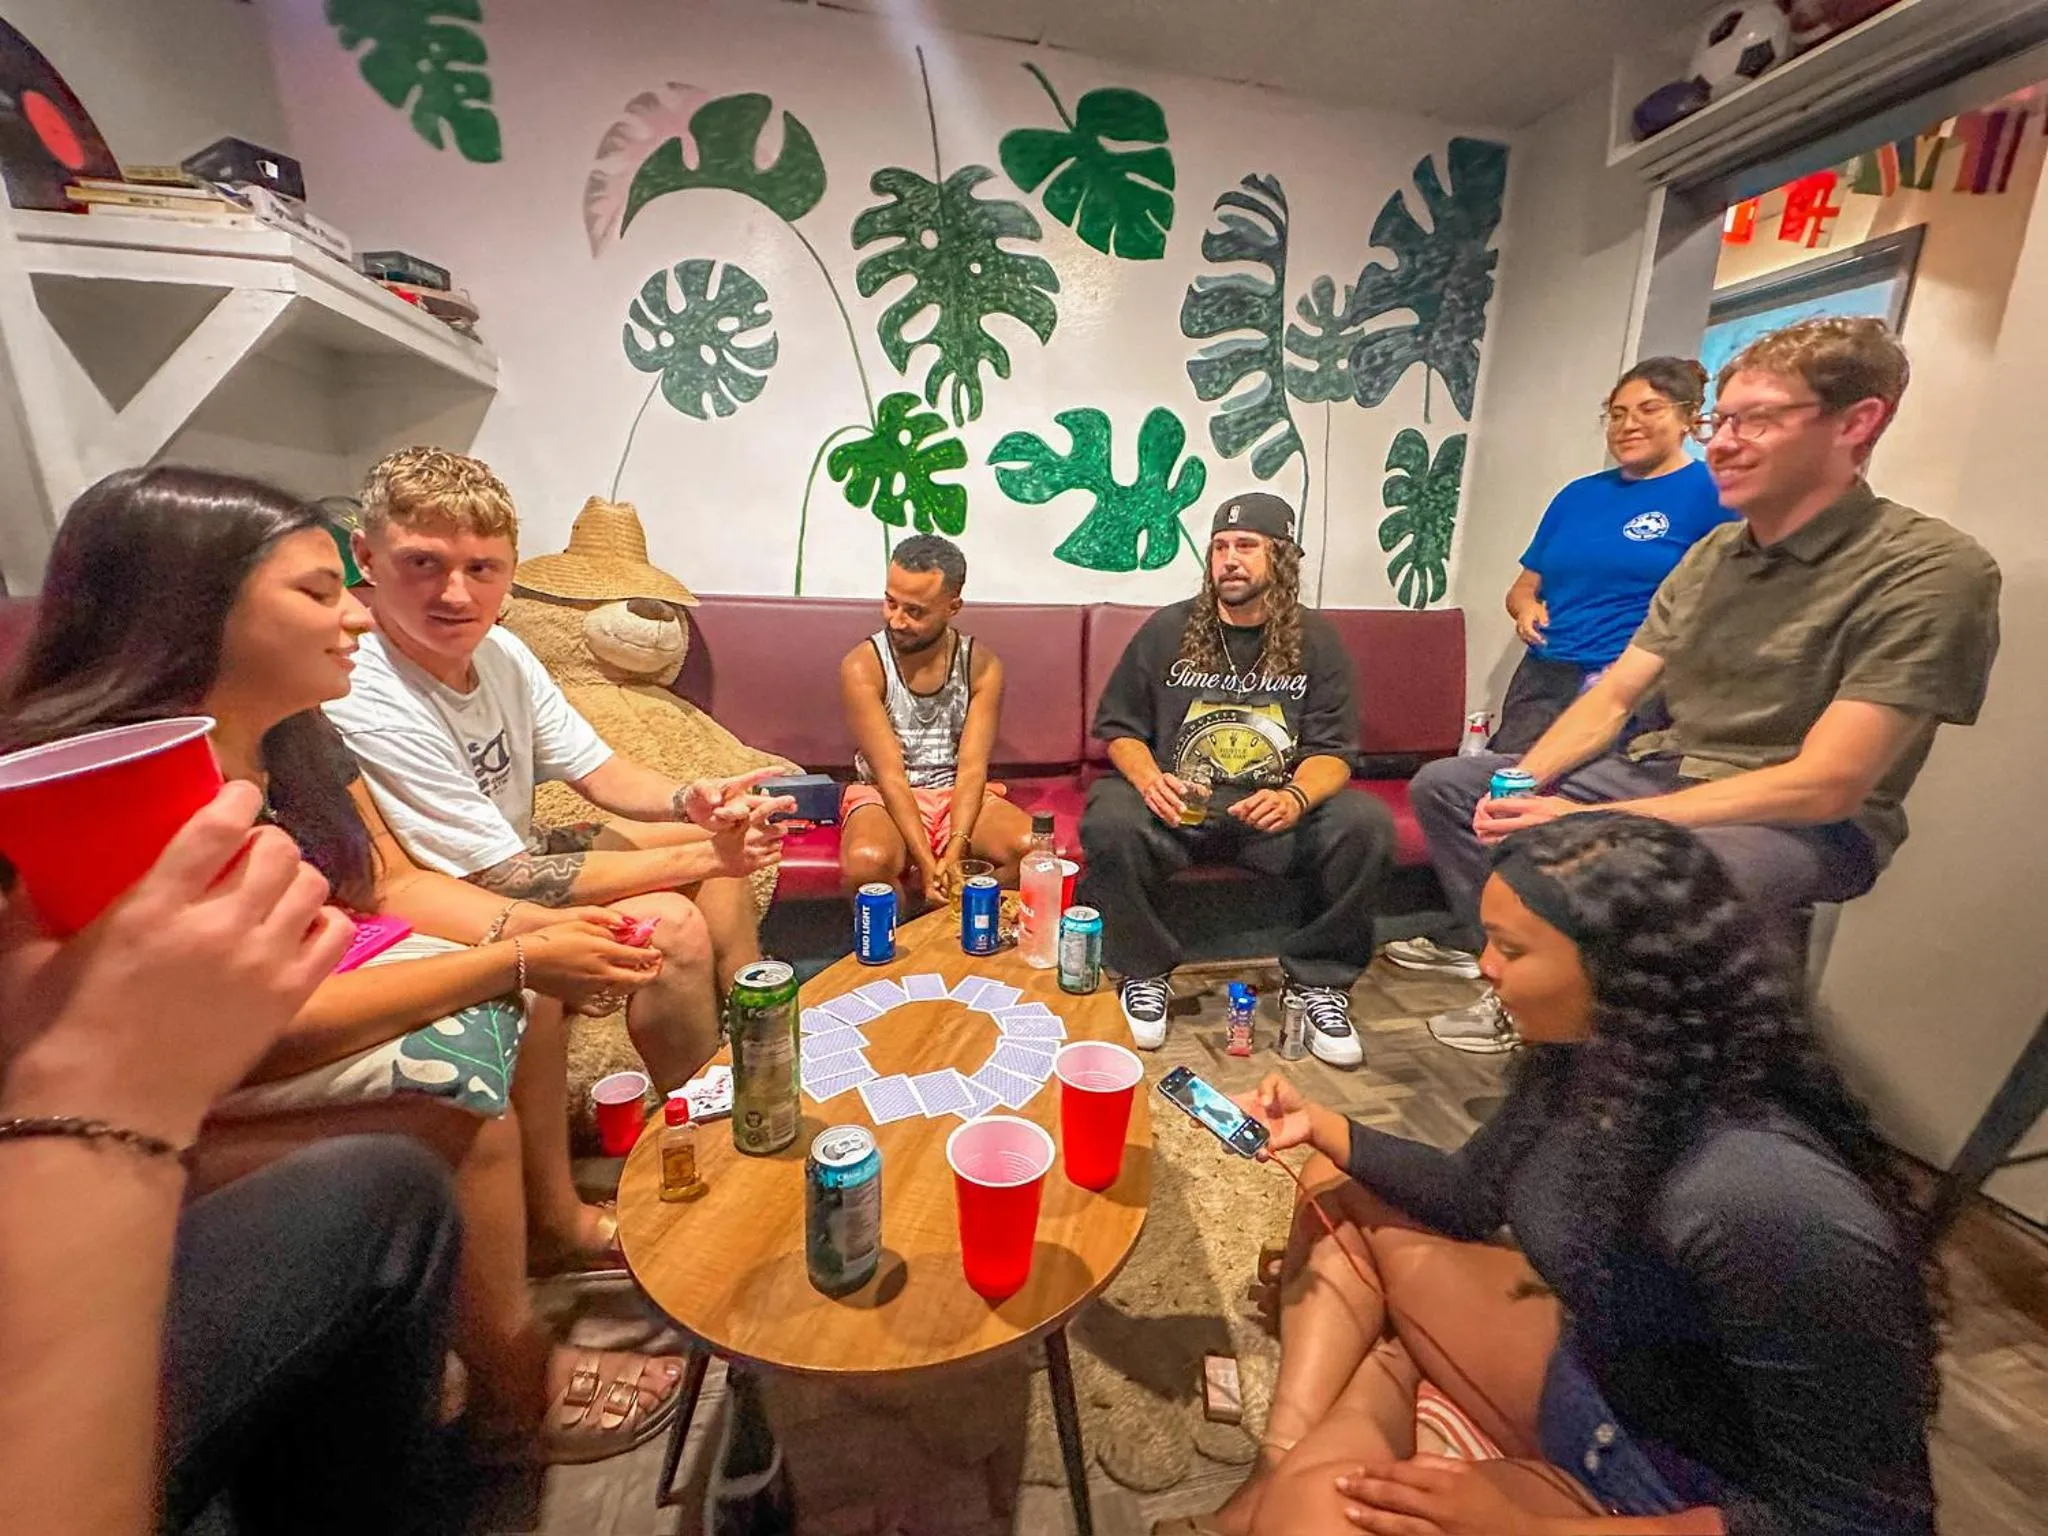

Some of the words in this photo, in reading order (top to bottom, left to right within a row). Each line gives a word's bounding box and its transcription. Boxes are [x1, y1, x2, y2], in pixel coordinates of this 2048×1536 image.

[1166, 658, 1220, 688] Time
[1221, 672, 1236, 690] is
[1241, 671, 1308, 700] Money
[862, 904, 870, 934] LIGHT
[862, 934, 870, 956] BUD
